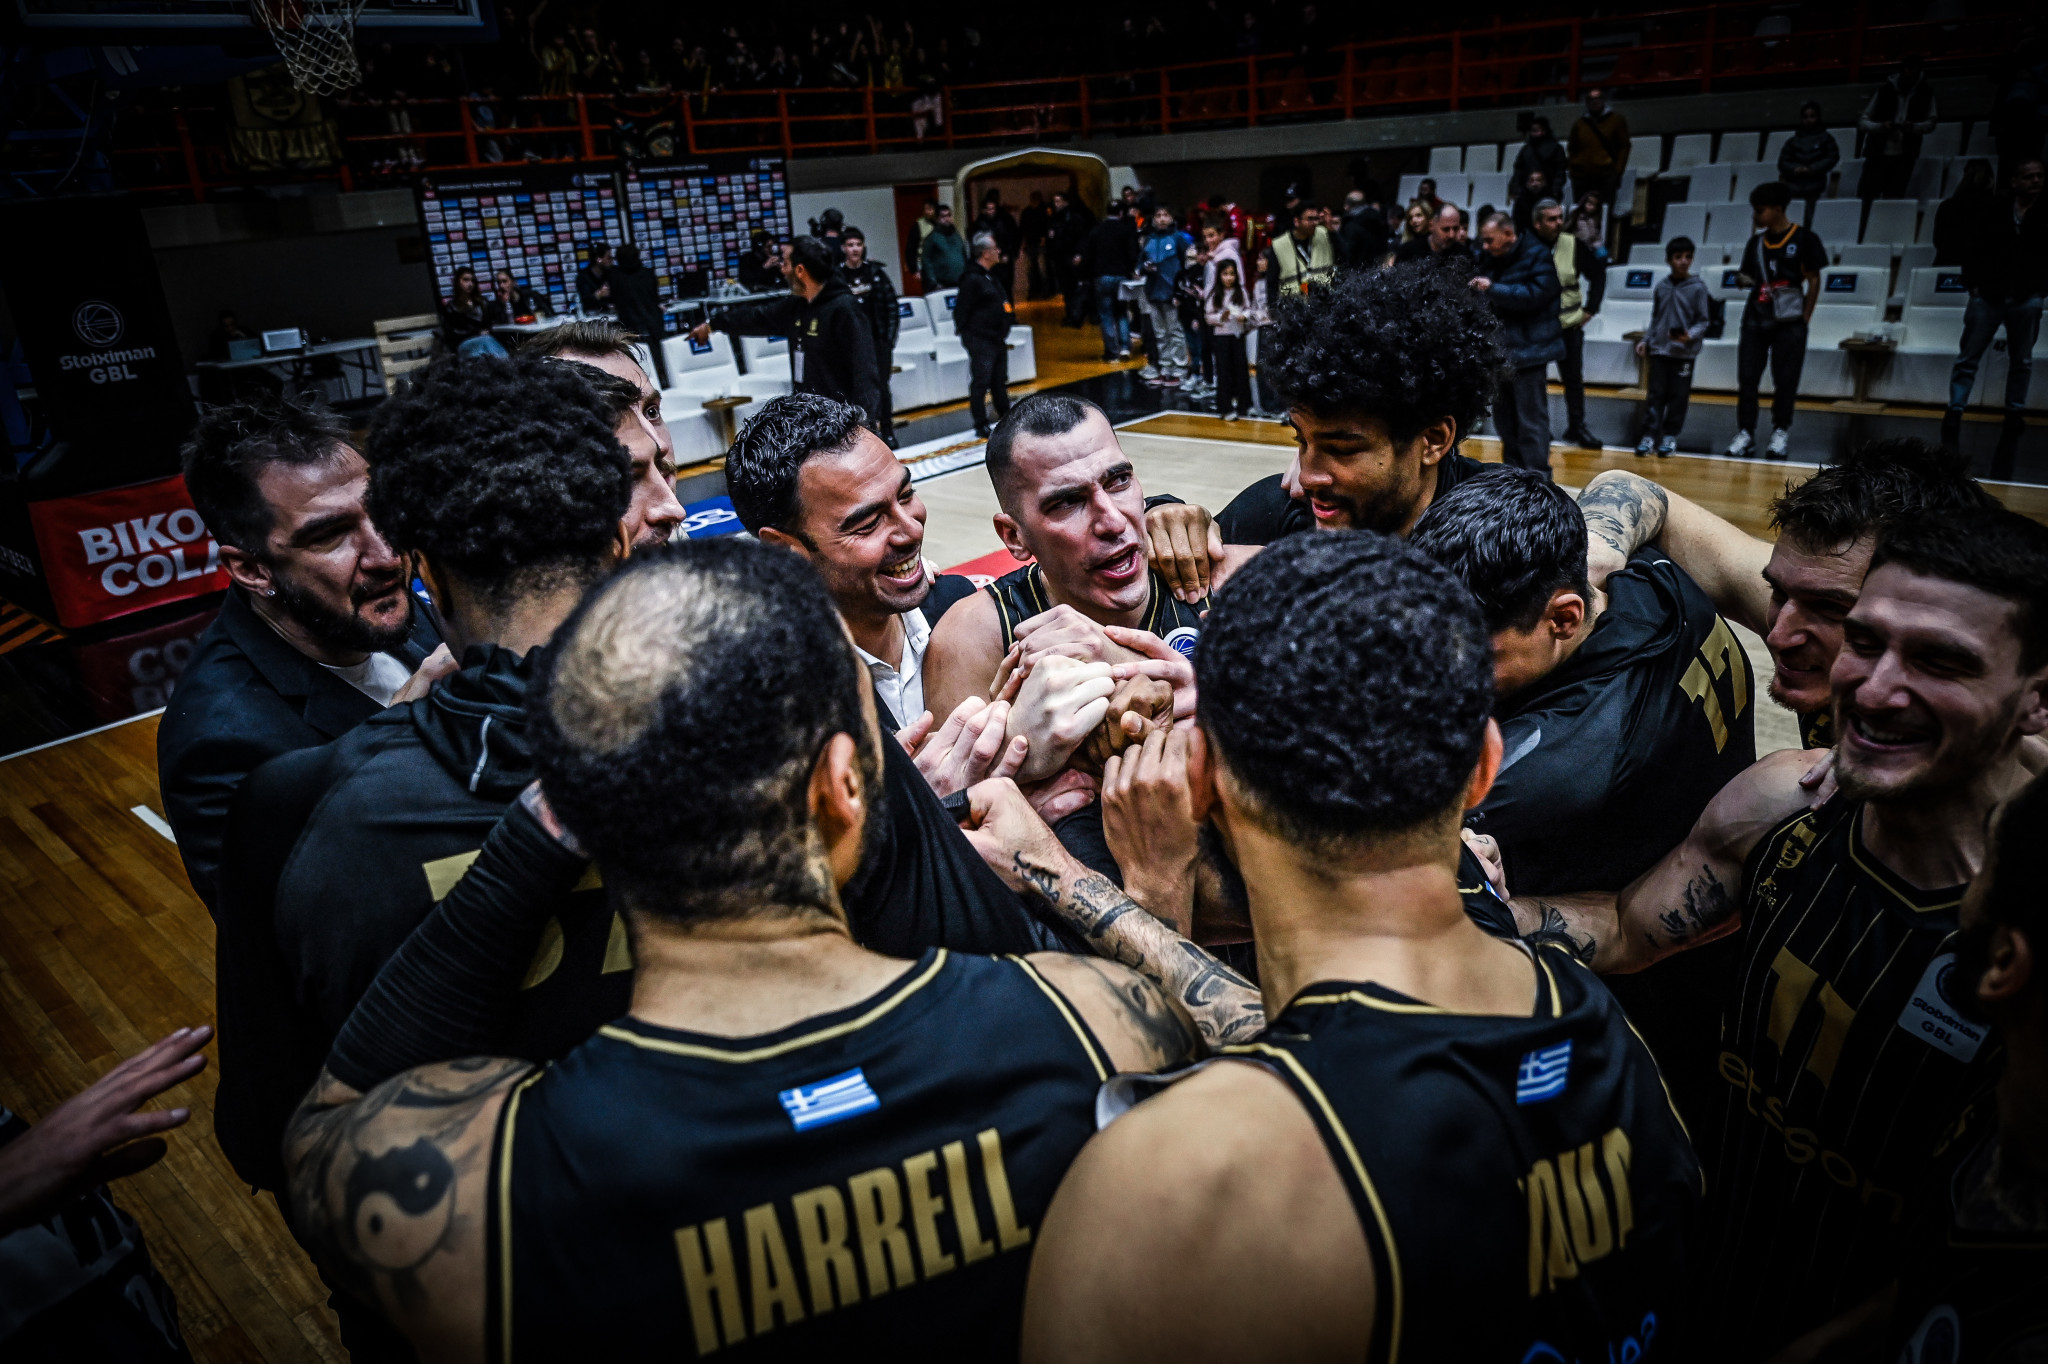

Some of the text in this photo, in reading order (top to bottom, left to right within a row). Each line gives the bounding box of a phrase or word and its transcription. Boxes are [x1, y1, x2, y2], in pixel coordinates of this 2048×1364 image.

[59, 346, 157, 371] Stoiximan
[89, 364, 139, 385] GBL
[78, 508, 213, 565] BIKO
[1678, 612, 1747, 755] 17
[1912, 997, 1980, 1042] Stoiximan
[1921, 1020, 1955, 1046] GBL
[1718, 1050, 1905, 1225] etsson
[672, 1127, 1033, 1358] HARRELL
